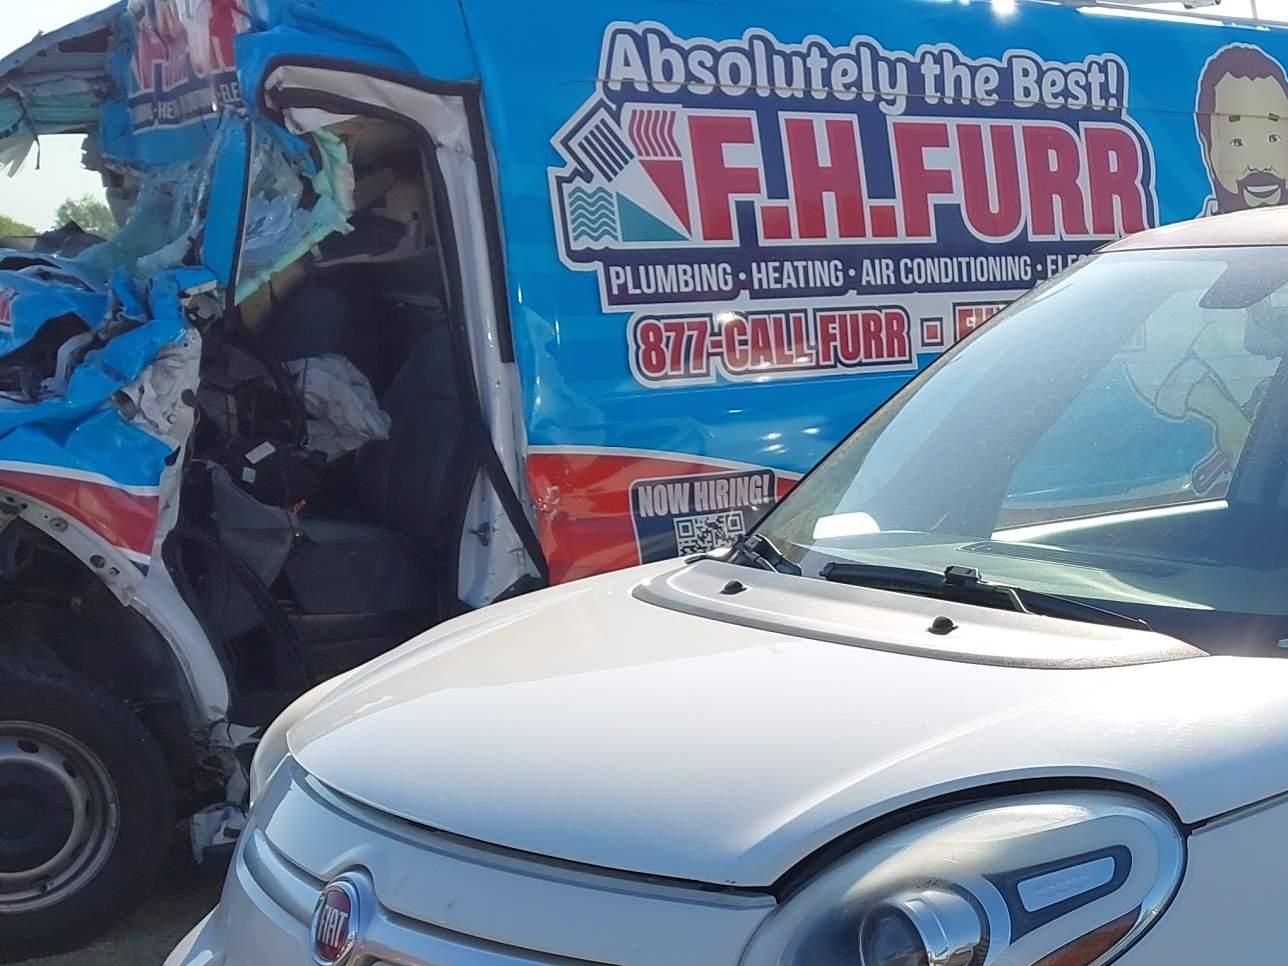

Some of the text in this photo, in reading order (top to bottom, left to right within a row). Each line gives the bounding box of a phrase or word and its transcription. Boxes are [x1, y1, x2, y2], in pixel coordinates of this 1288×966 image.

[607, 32, 1119, 116] Absolutely the Best!
[608, 262, 734, 296] PLUMBING
[751, 259, 844, 290] HEATING
[861, 256, 896, 286] AIR
[899, 254, 1032, 285] CONDITIONING
[639, 313, 814, 375] 877-CALL
[818, 309, 909, 365] FURR
[637, 473, 770, 518] NOW HIRING!
[317, 903, 349, 949] FIAT
